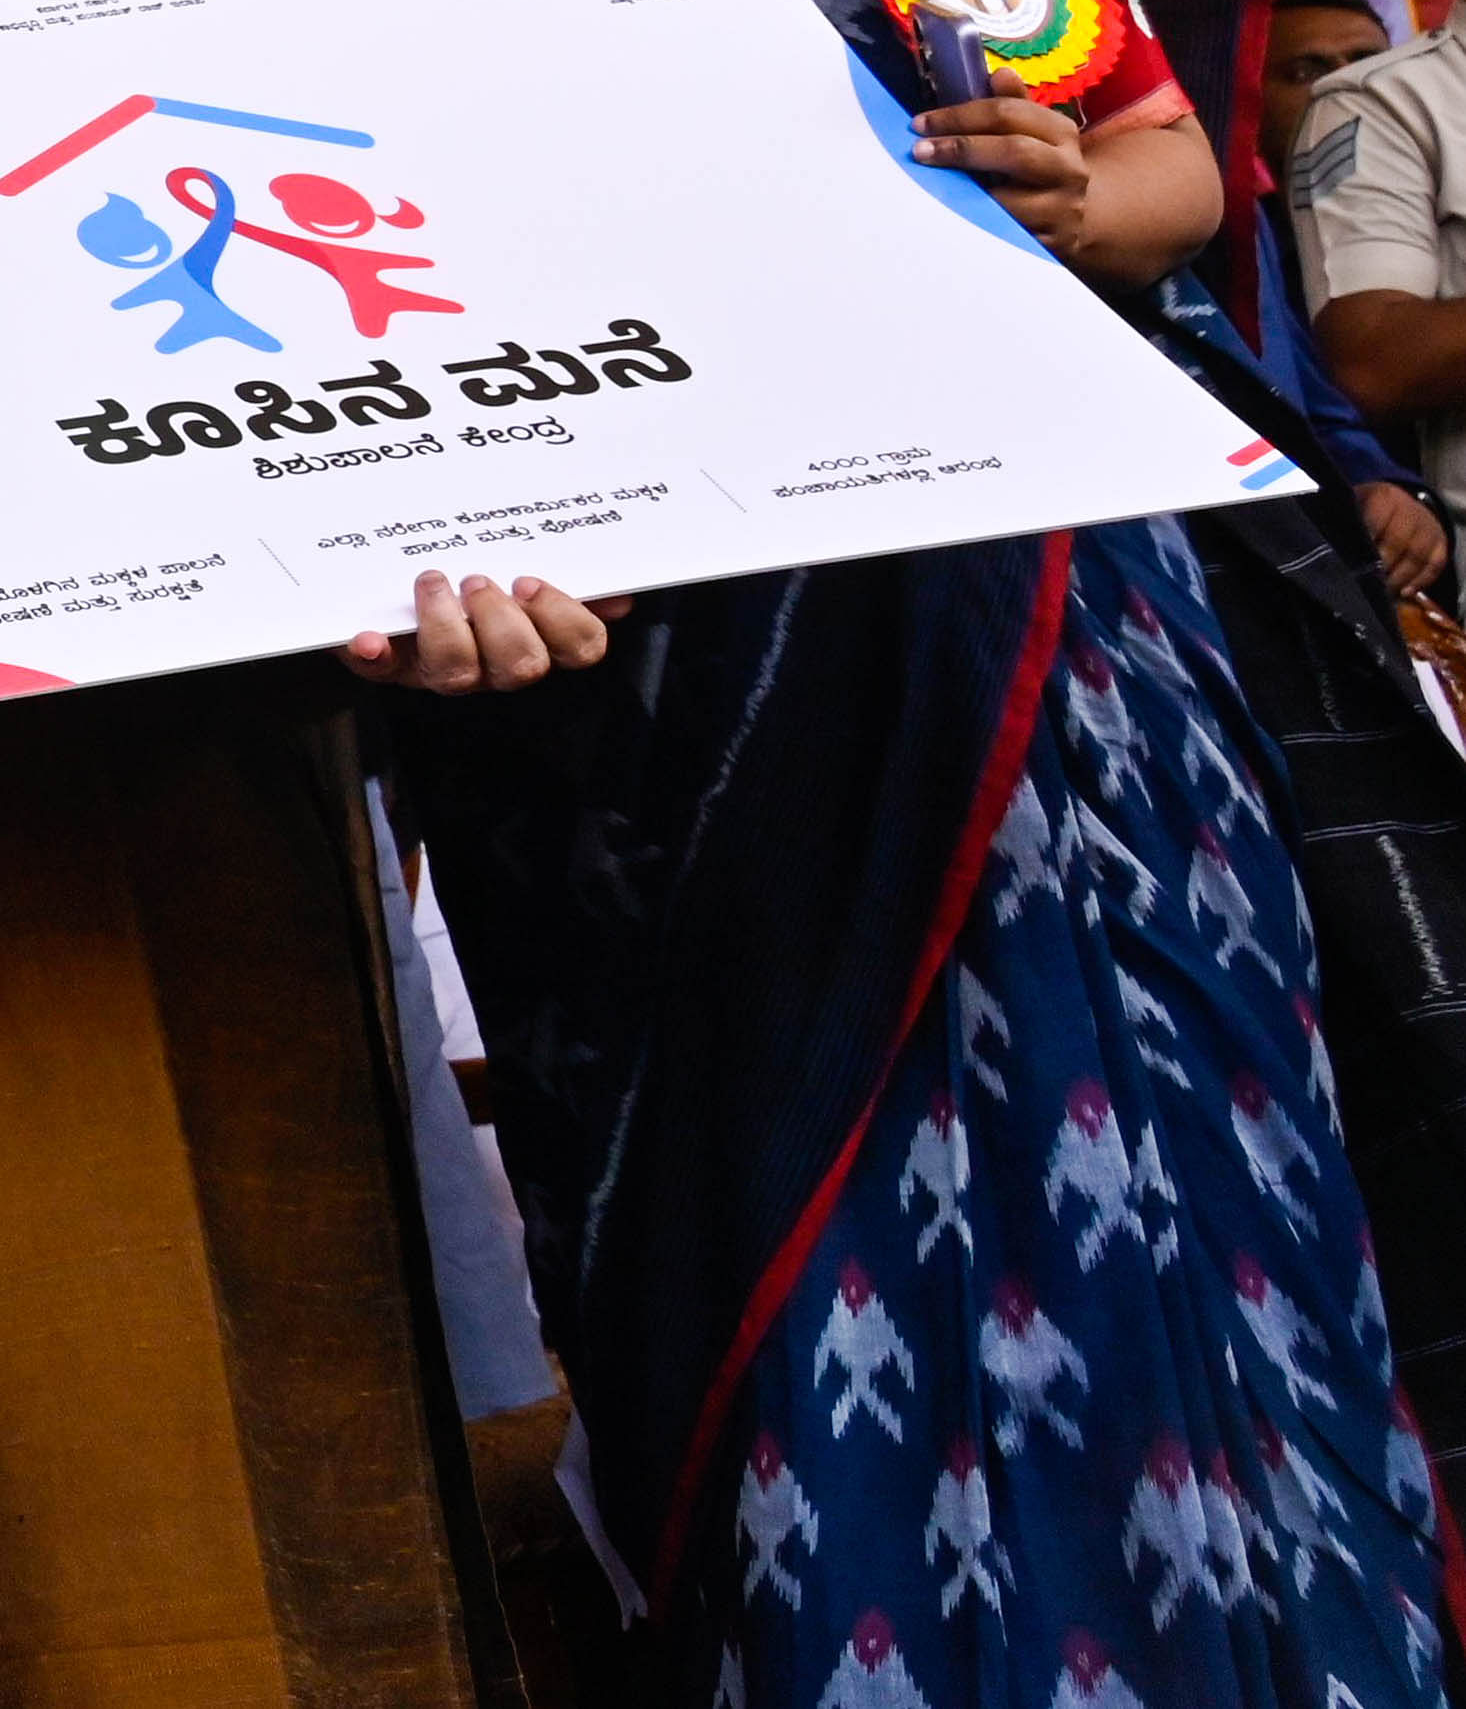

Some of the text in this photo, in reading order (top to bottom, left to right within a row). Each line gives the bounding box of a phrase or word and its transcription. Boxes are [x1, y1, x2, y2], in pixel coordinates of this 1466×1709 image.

[54, 318, 693, 465] ಕೂಸಿನ ಮನೆ
[252, 414, 575, 480] ಶಿಶುಪಾಲನೆ ಕೇಂದ್ರ
[807, 447, 932, 472] 4000 ಗ್ರಾಮ
[937, 456, 1003, 475] ಆರಂಭ
[317, 532, 371, 549] ಎಲ್ಲಾ
[373, 519, 448, 539] ನರೇಗಾ
[610, 482, 669, 502] ಮಕ್ಕಳ
[400, 533, 468, 556] ಪಾಲನೆ
[475, 524, 535, 543] ಮತ್ತು
[87, 565, 148, 588] ಮಕ್ಕಳ
[158, 553, 226, 575] ಪಾಲನೆ
[61, 594, 122, 613] ಮತ್ತು
